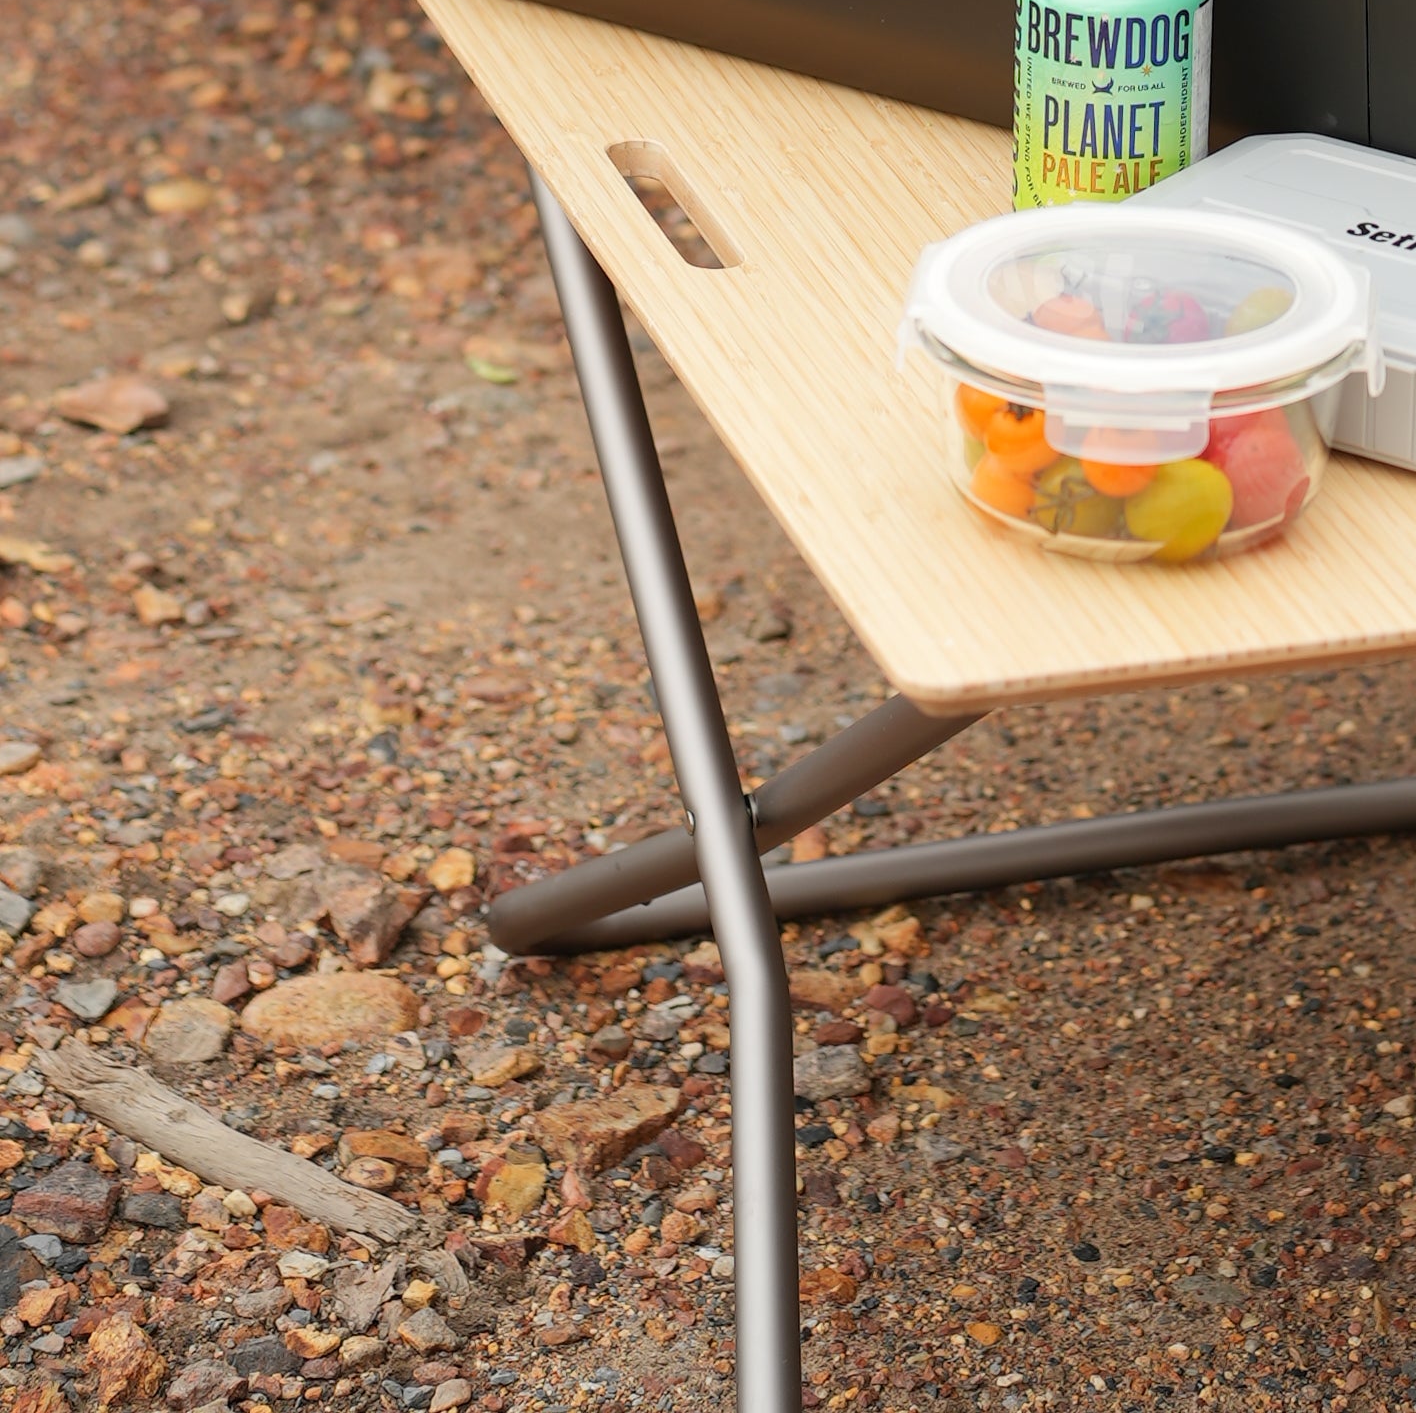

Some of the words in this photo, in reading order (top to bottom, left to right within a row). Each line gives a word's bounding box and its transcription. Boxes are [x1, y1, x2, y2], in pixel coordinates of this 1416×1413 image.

[1028, 0, 1190, 70] BREWDOG
[1051, 77, 1086, 90] BREWED
[1118, 84, 1136, 92] FOR
[1137, 83, 1149, 91] US
[1150, 82, 1166, 90] ALL
[1179, 66, 1189, 147] INDEPENDENT
[1043, 94, 1166, 160] PLANET
[1042, 151, 1106, 194] PALE
